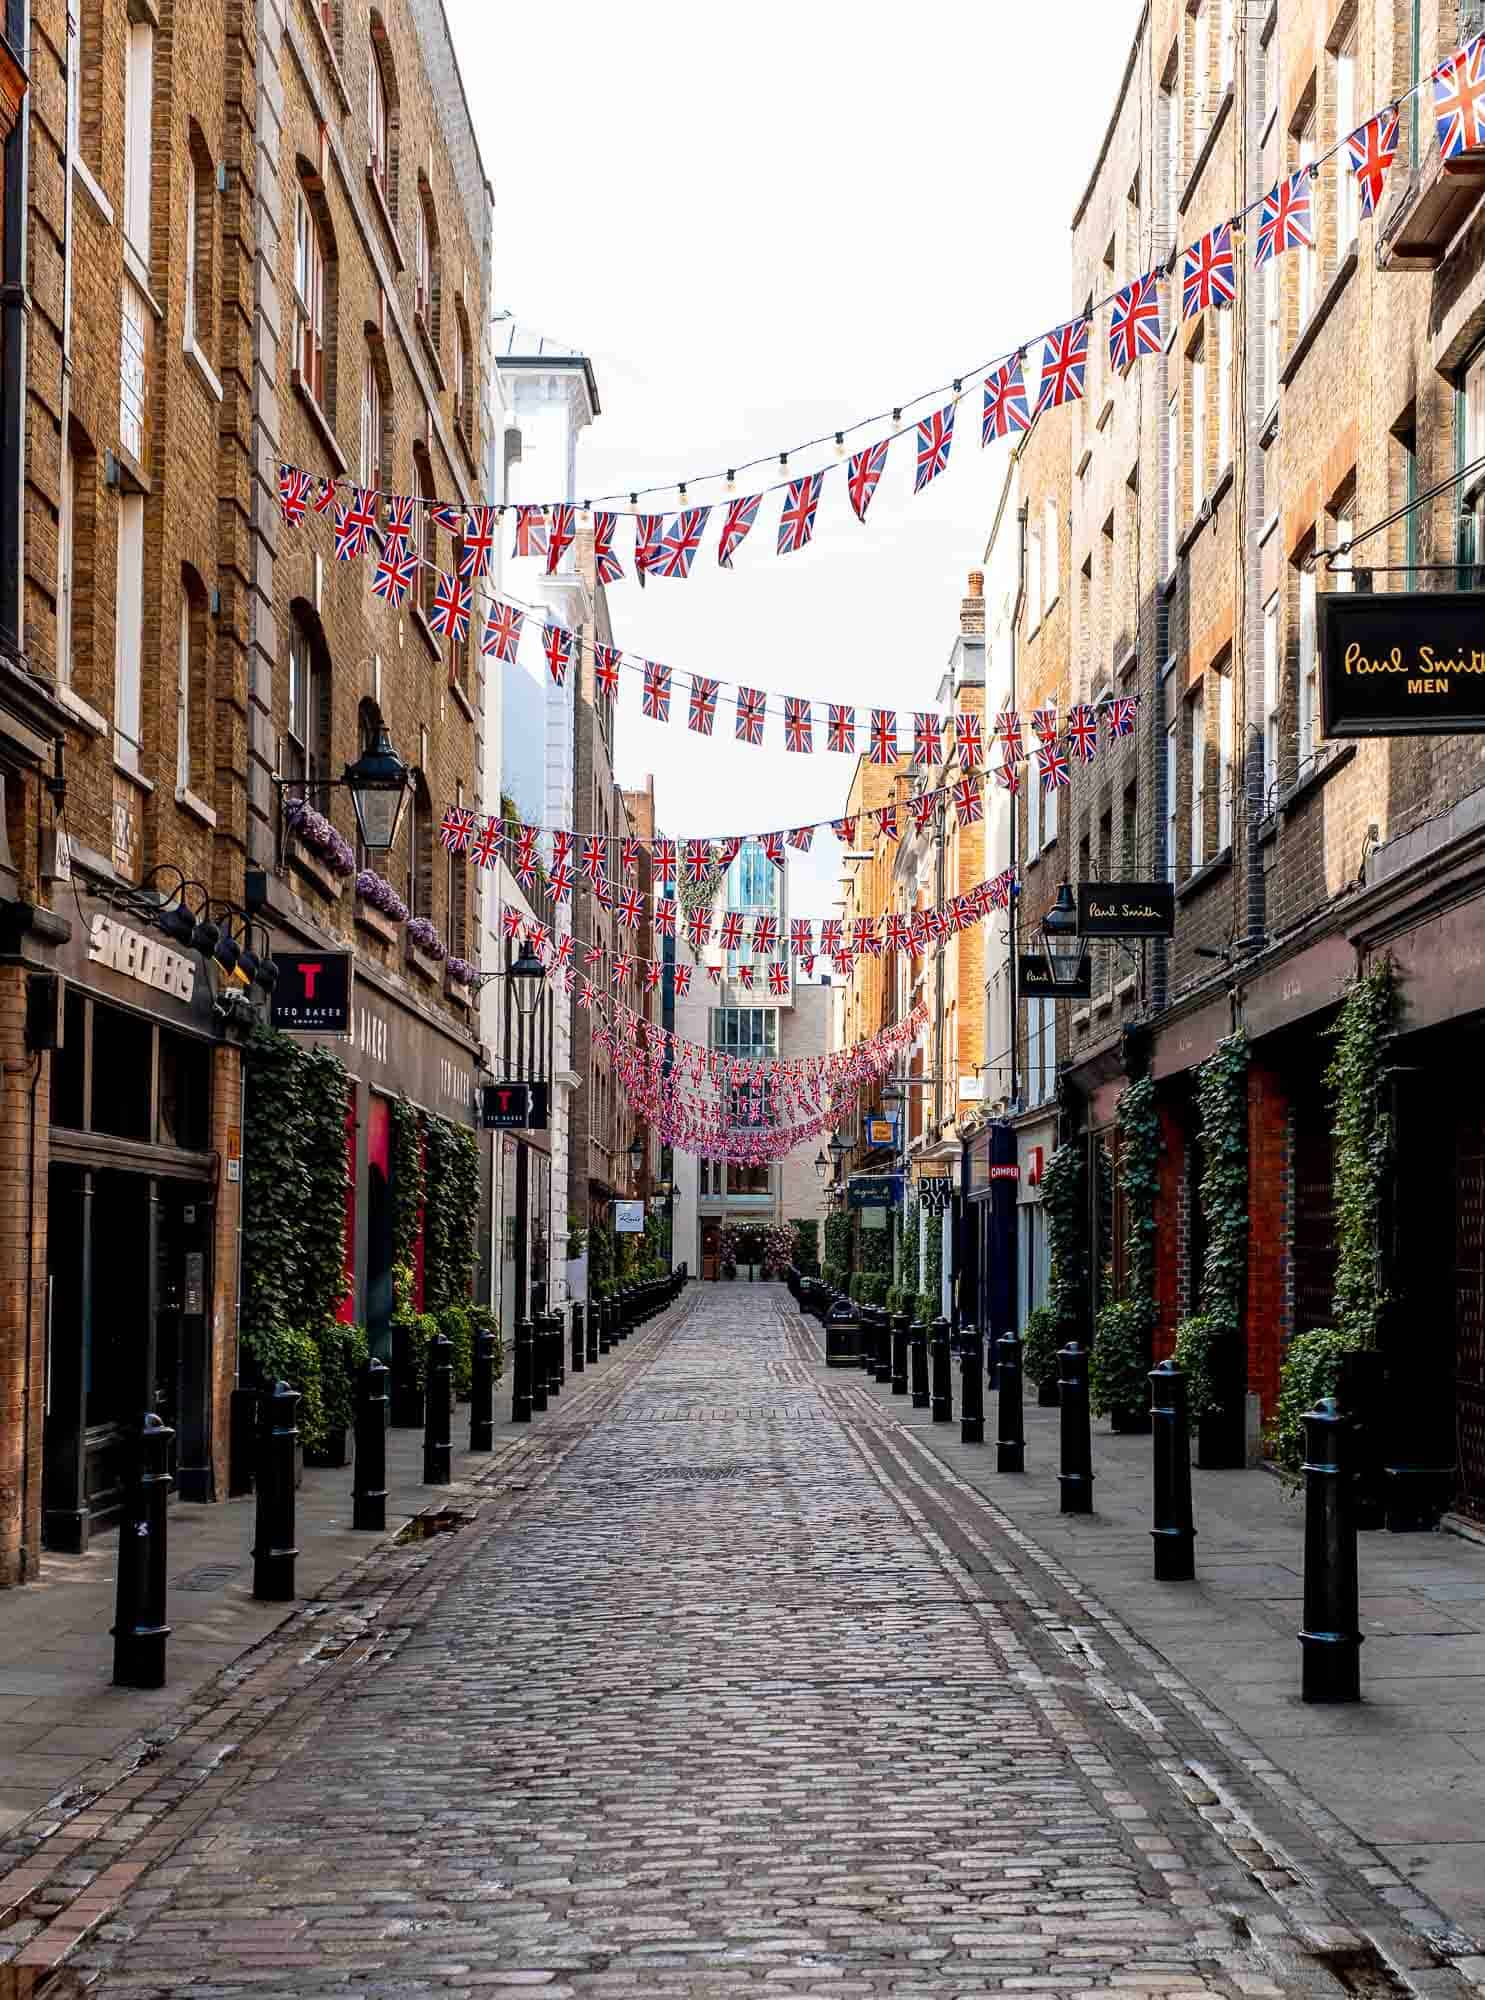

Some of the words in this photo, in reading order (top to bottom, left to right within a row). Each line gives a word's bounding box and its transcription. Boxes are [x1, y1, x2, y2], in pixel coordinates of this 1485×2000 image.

[1344, 642, 1409, 675] Paul
[1407, 679, 1449, 694] MEN
[1089, 902, 1118, 918] Paul
[1121, 904, 1162, 918] Smith
[297, 963, 322, 999] T
[277, 1007, 297, 1016] TED
[305, 1007, 341, 1017] BAKER
